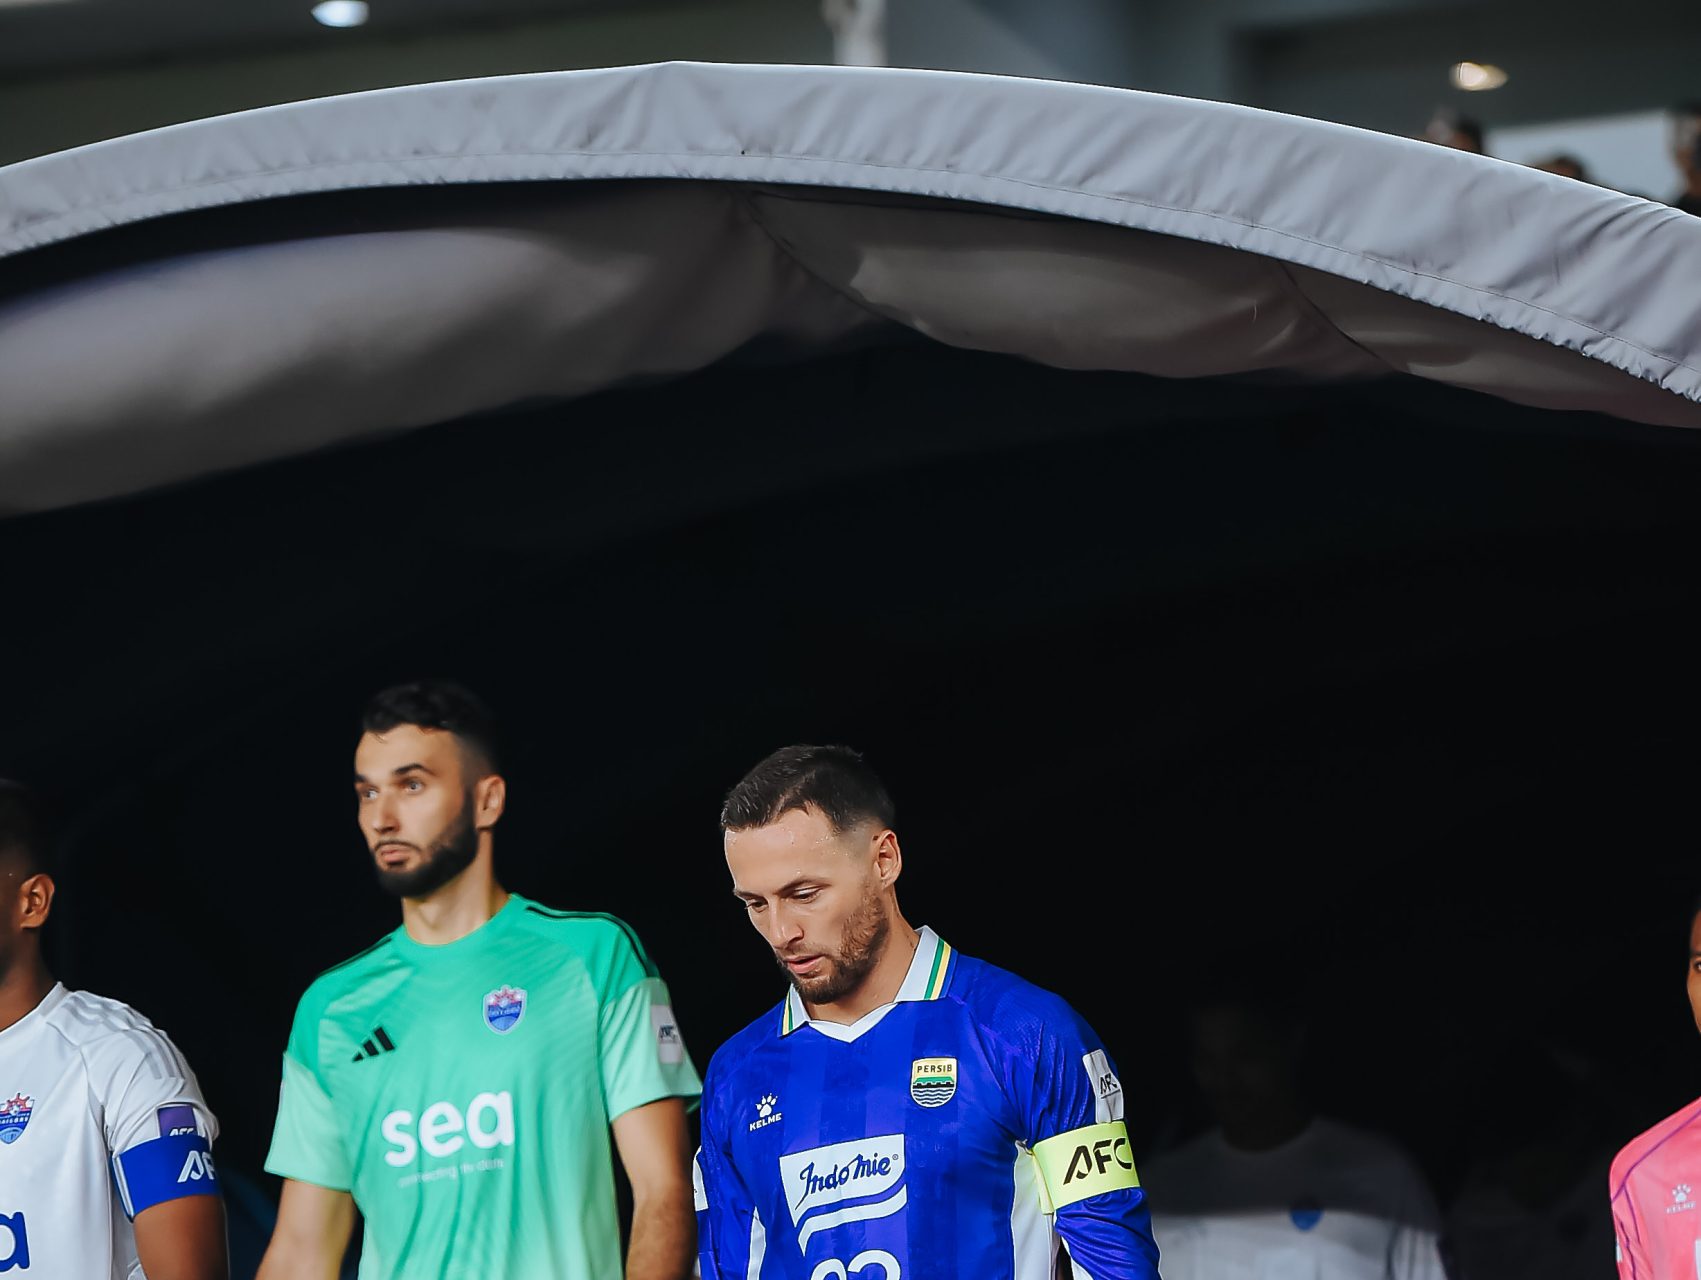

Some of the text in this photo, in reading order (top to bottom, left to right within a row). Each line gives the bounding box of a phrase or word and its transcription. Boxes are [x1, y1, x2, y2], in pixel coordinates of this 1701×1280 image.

[916, 1064, 953, 1073] PERSIB
[381, 1090, 515, 1167] sea
[749, 1112, 782, 1132] KELME
[1063, 1137, 1133, 1186] AFC
